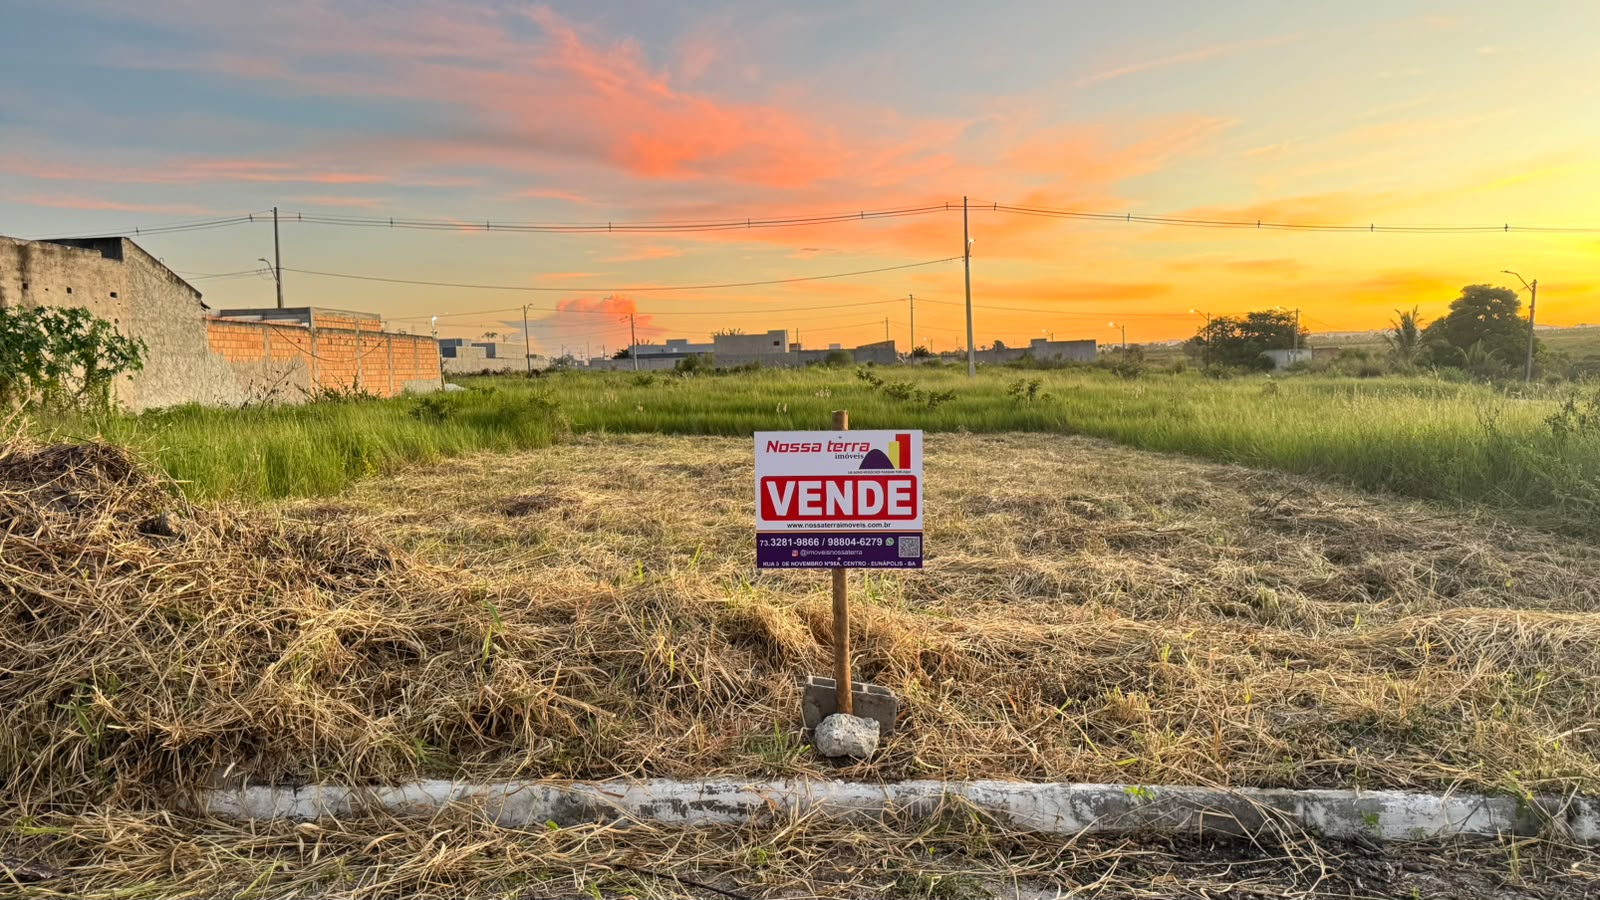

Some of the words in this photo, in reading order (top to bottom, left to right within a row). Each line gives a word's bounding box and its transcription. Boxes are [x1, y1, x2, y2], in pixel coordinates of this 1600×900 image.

[766, 440, 822, 453] Nossa
[827, 440, 870, 452] terra
[766, 480, 912, 516] VENDE
[760, 538, 819, 546] 73.3281-9866
[828, 538, 883, 546] 98804-6279
